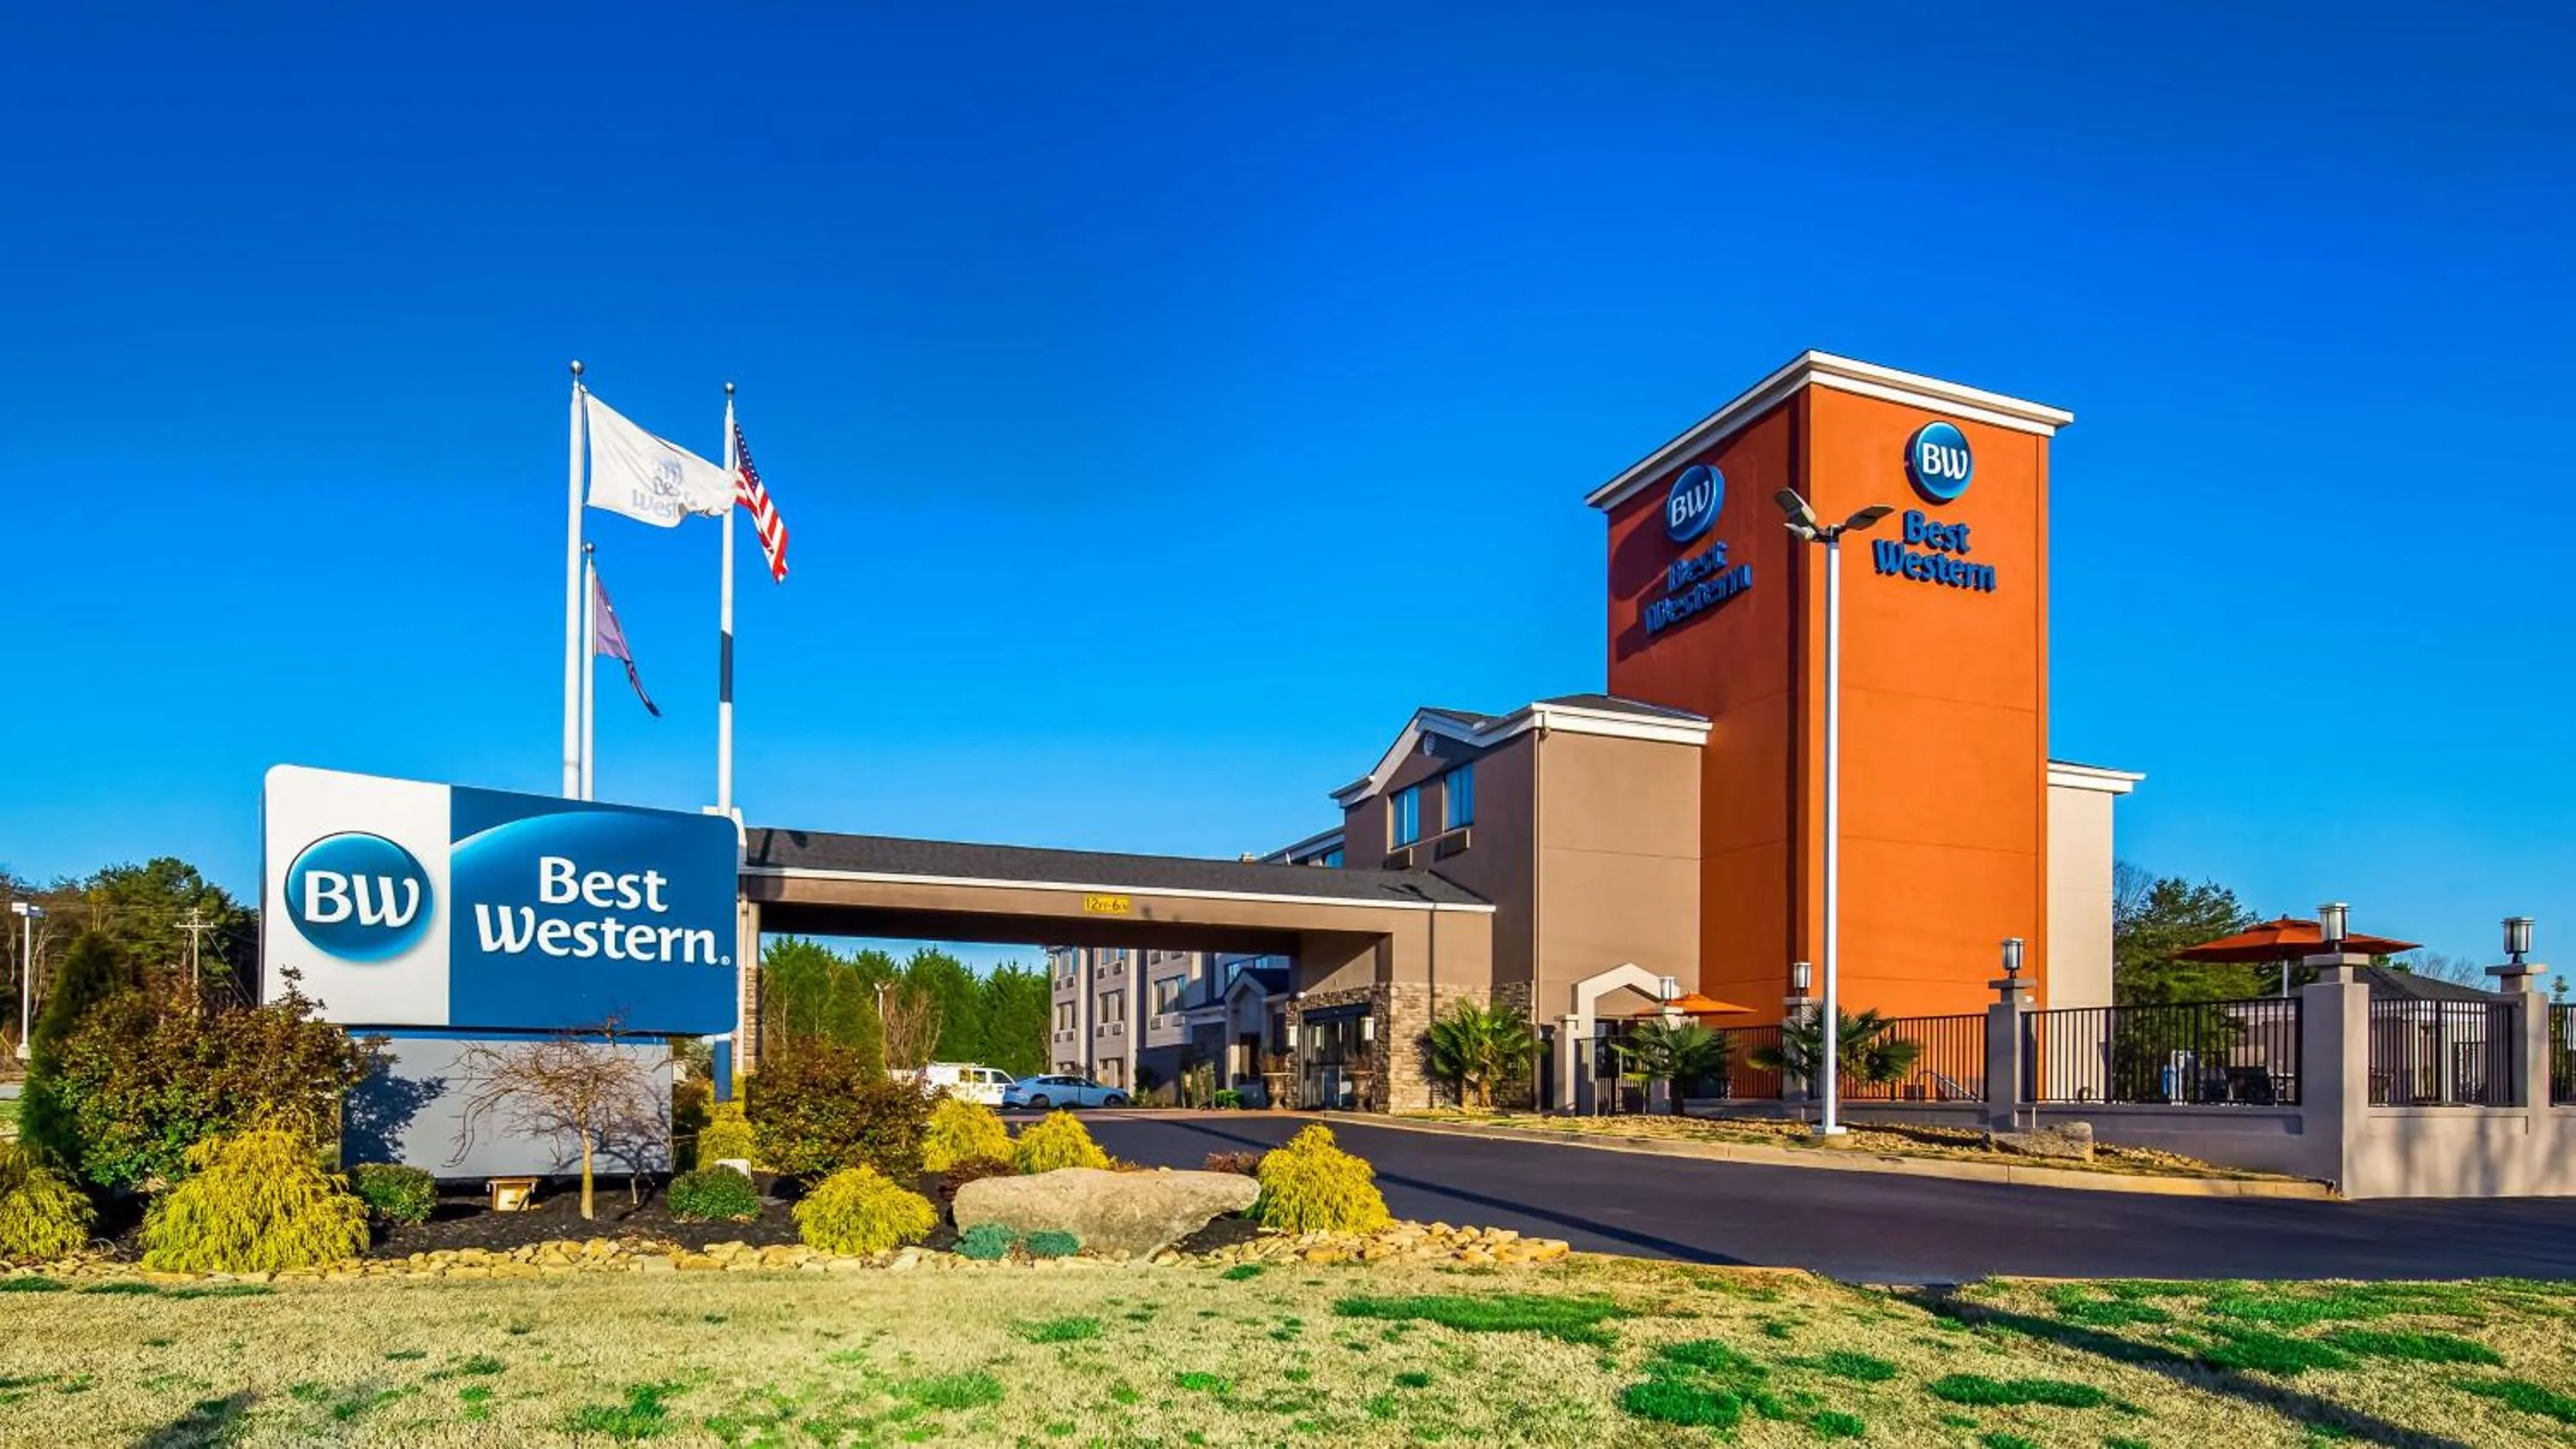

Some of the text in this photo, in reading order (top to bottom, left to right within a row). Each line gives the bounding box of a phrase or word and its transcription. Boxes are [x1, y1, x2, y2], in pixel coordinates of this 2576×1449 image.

[1923, 442, 1968, 480] BW
[1671, 480, 1710, 527] BW
[1903, 510, 1971, 555] Best
[1871, 538, 1996, 592] Western
[305, 870, 420, 927] BW
[540, 856, 668, 912] Best
[475, 903, 719, 966] Western
